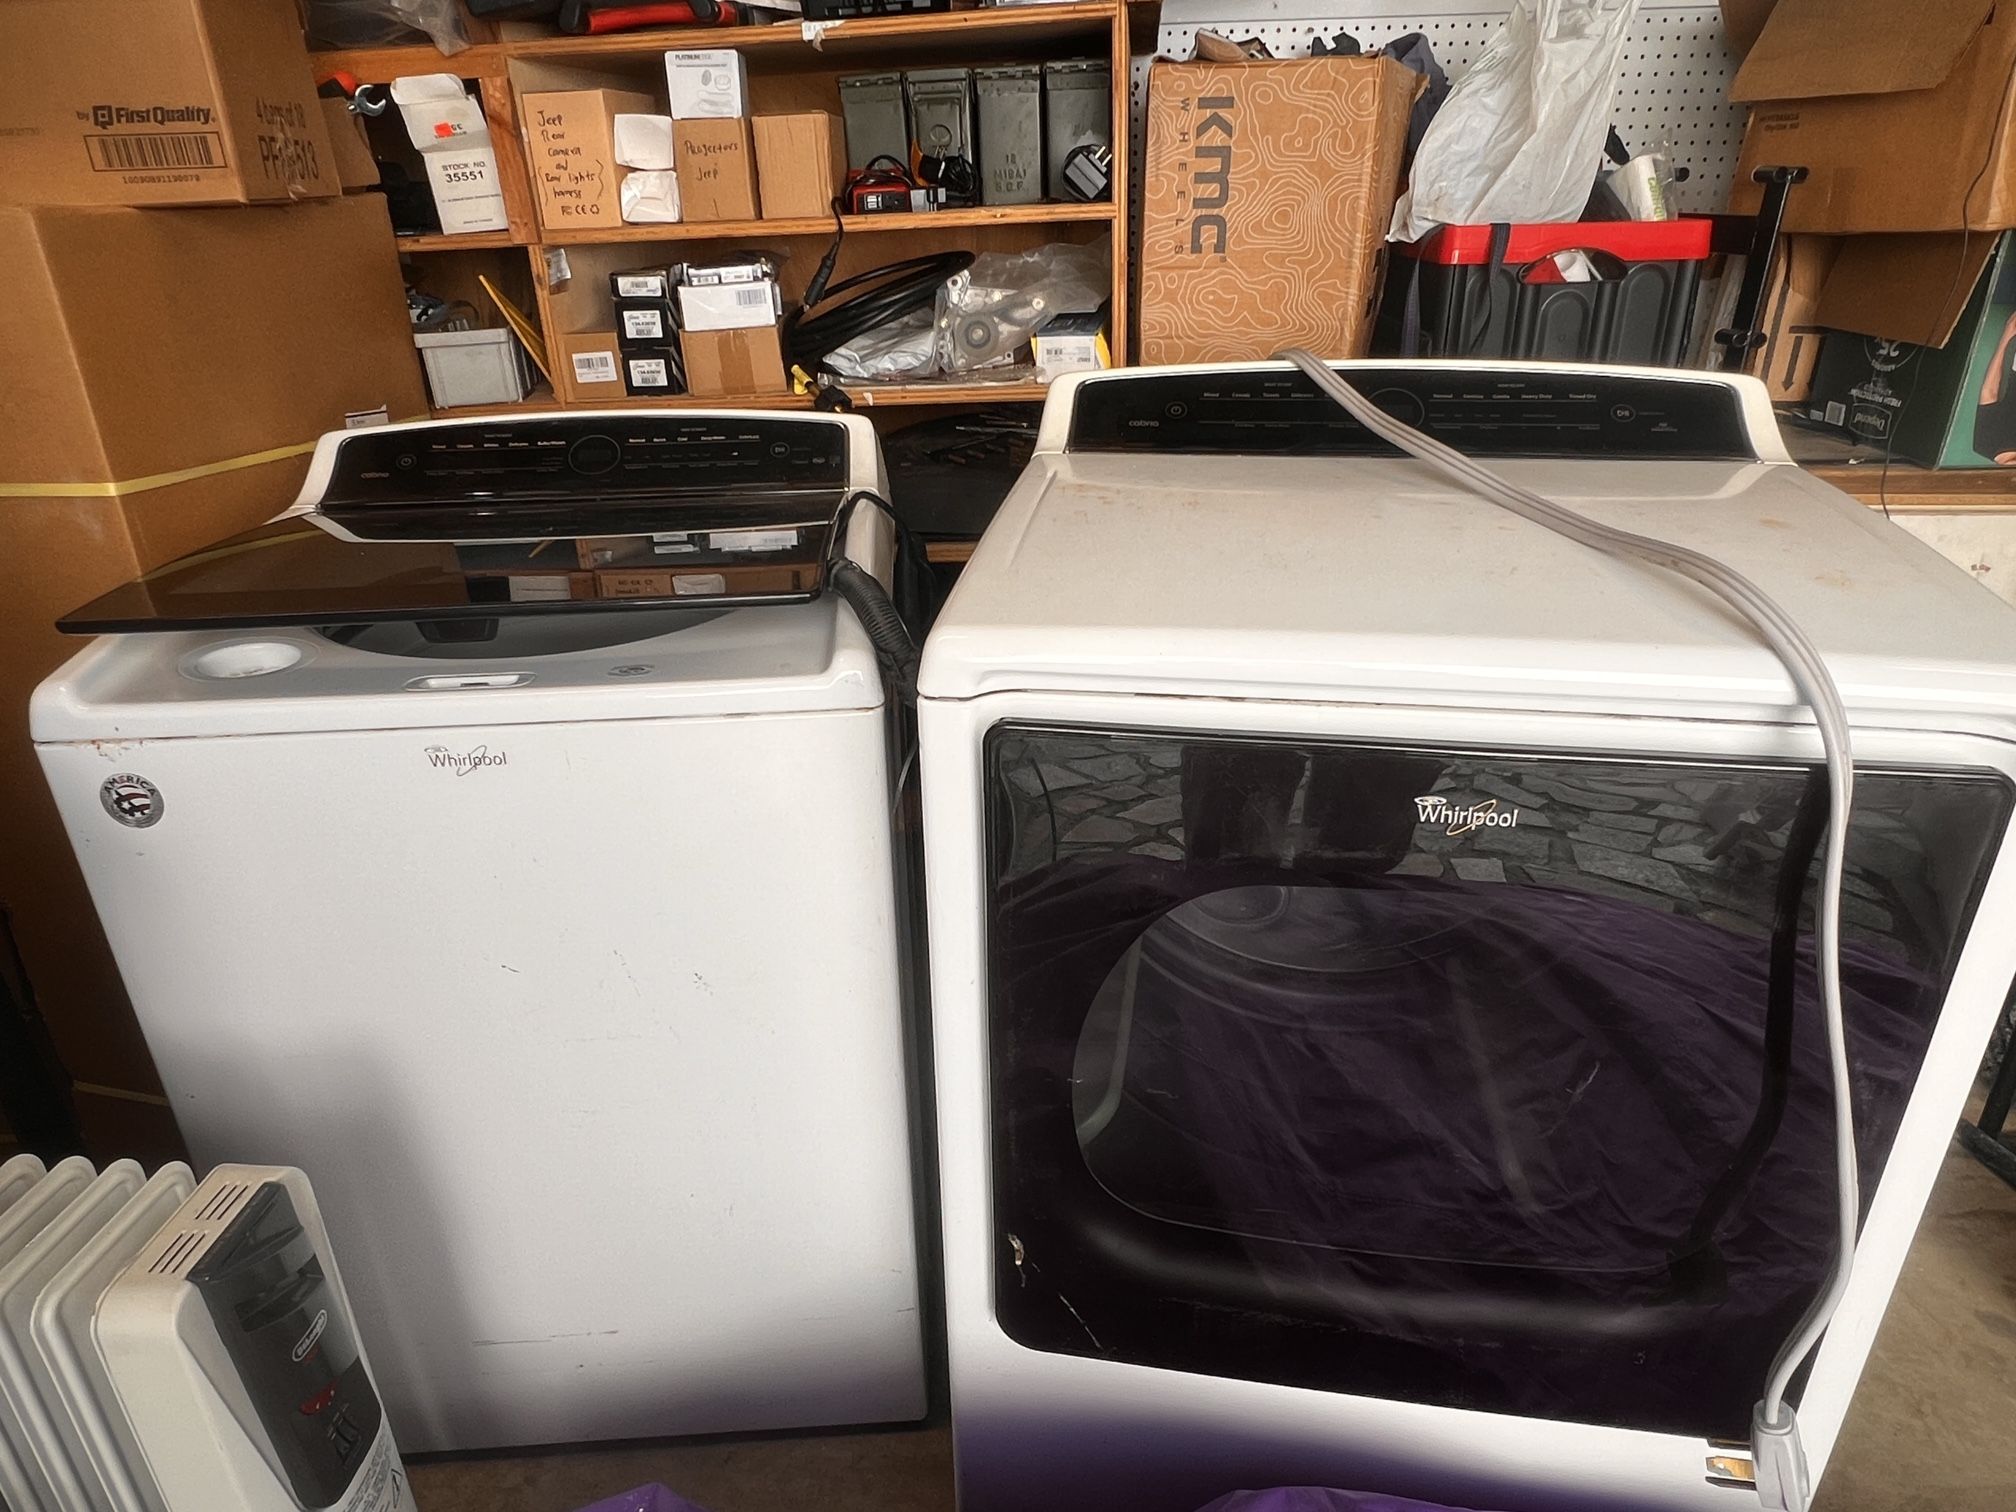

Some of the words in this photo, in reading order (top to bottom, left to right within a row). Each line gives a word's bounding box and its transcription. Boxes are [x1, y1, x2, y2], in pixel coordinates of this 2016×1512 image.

[537, 110, 563, 127] Jeep
[441, 163, 469, 172] STOCK
[696, 167, 718, 181] Jeep
[1174, 96, 1190, 255] WHEELS
[445, 170, 484, 184] 35551
[1128, 419, 1160, 427] cabrio
[1853, 412, 1886, 431] Depend
[426, 748, 508, 772] Whirlpool
[104, 775, 157, 797] AMERICA
[1415, 802, 1519, 832] Whirlpool
